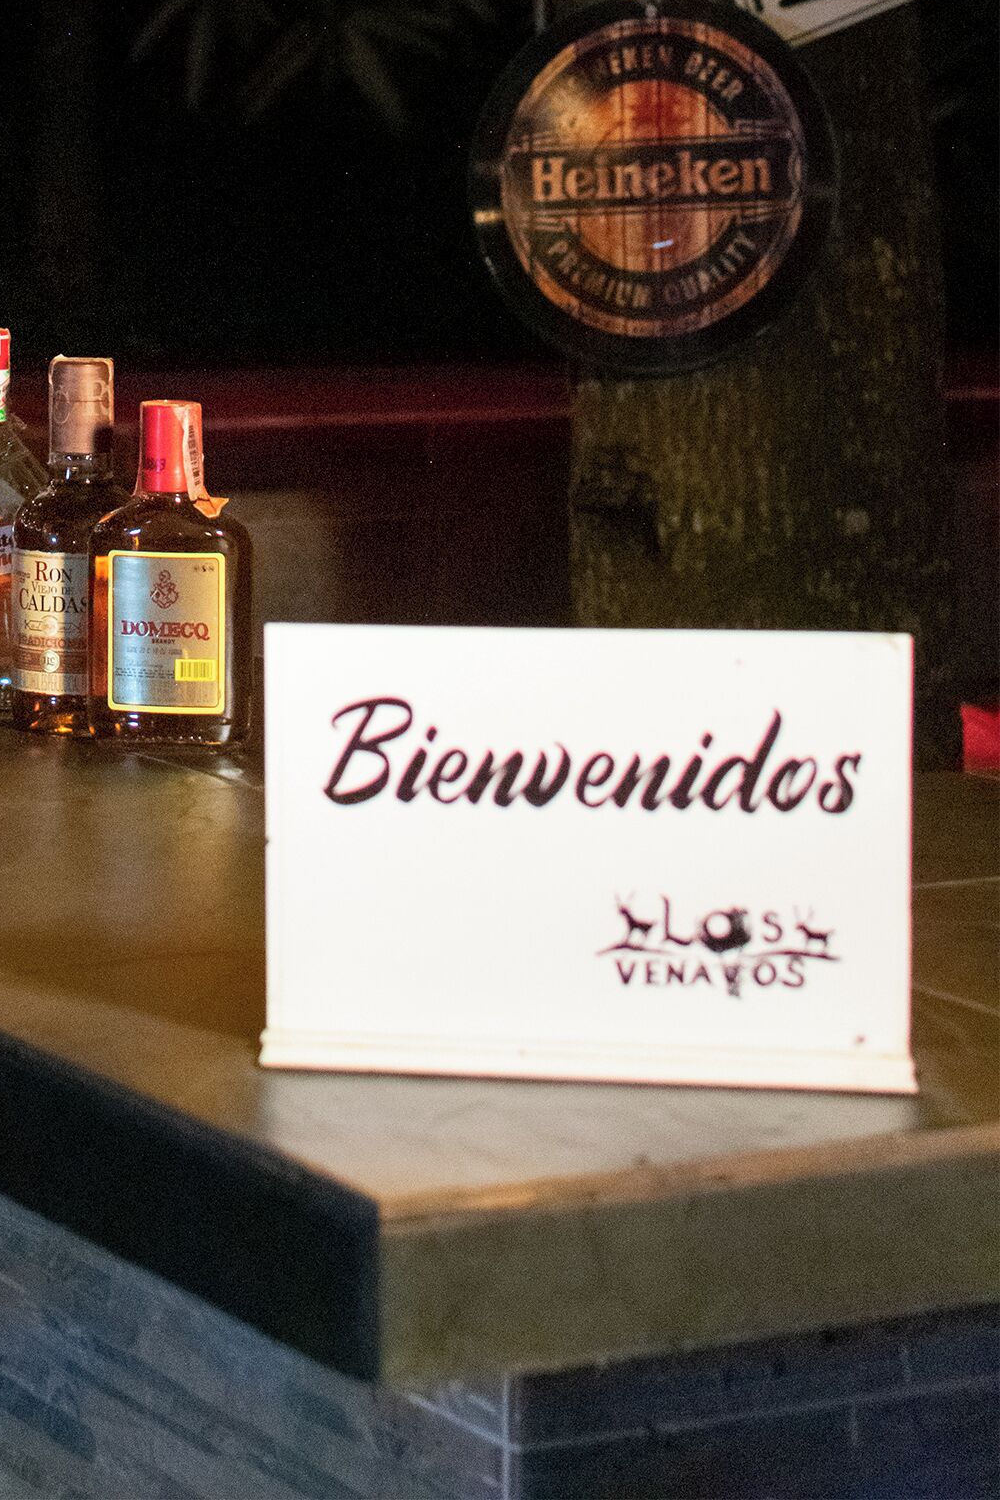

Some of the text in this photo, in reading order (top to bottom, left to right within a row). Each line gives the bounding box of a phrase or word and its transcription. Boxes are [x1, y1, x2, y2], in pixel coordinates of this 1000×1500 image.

[531, 150, 774, 202] Heineken
[35, 560, 72, 583] RON
[121, 619, 210, 641] DOMECQ
[323, 696, 864, 815] Bienvenidos
